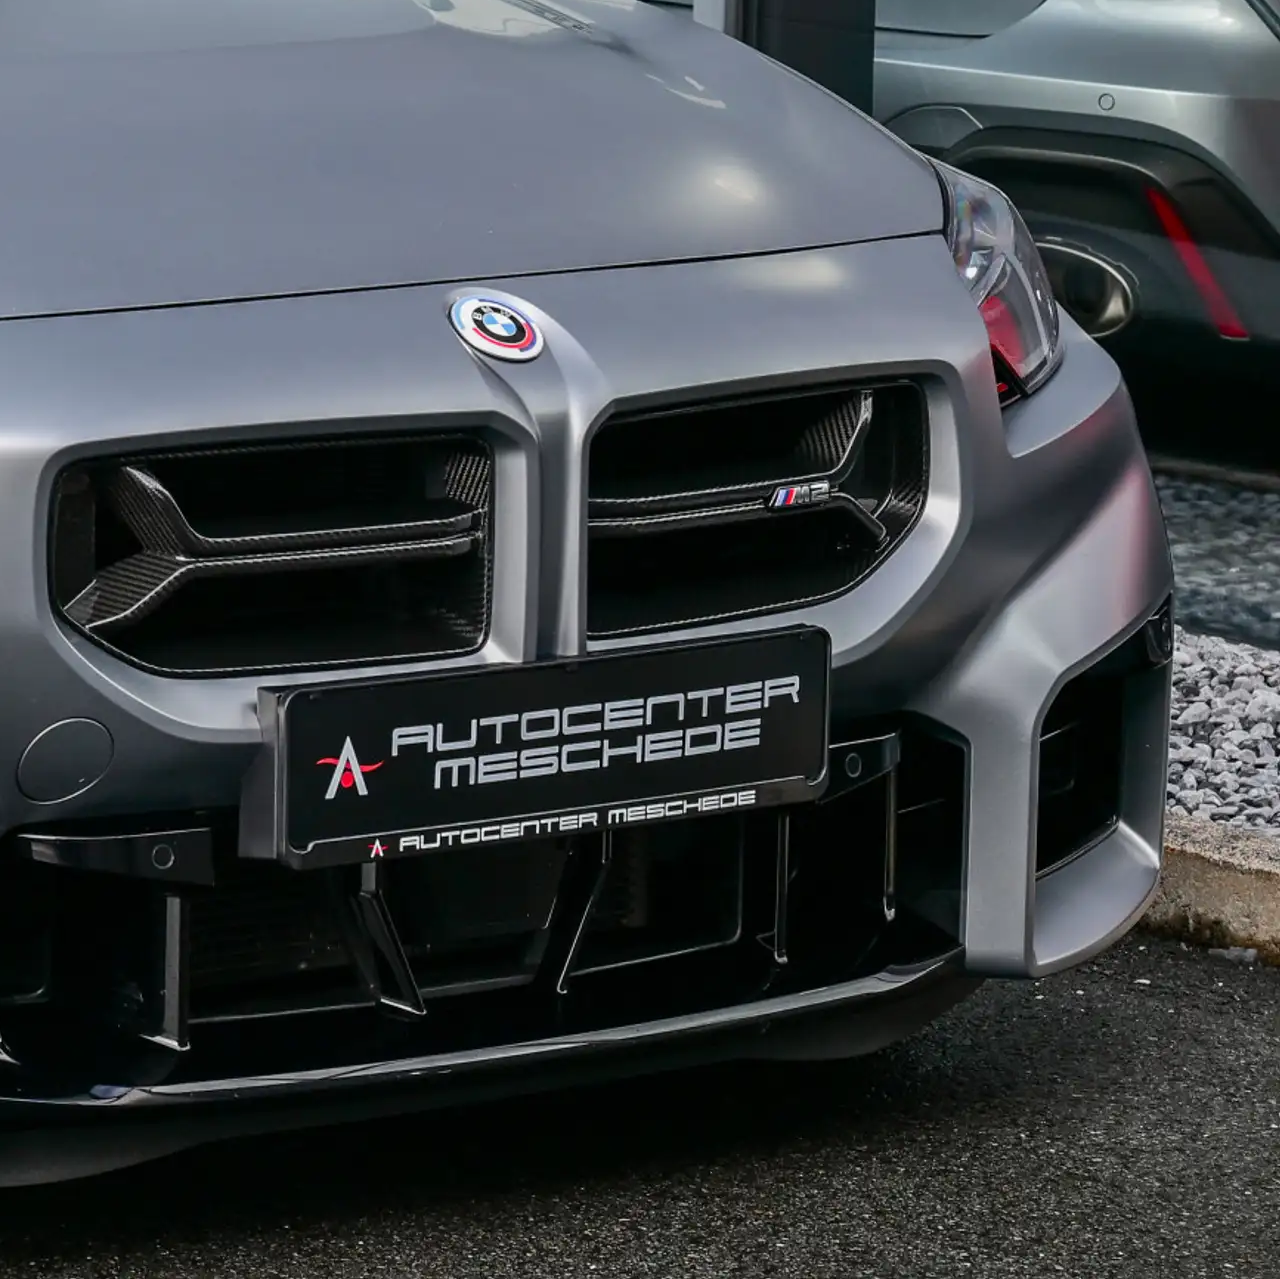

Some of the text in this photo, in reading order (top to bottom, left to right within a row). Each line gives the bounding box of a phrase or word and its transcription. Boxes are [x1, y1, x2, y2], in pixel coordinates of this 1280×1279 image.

[785, 481, 830, 505] M2
[392, 675, 800, 757] AUTOCENTER
[434, 718, 762, 790] MESCHEDE
[399, 790, 756, 852] AUTOCENTER MESCHEDE
